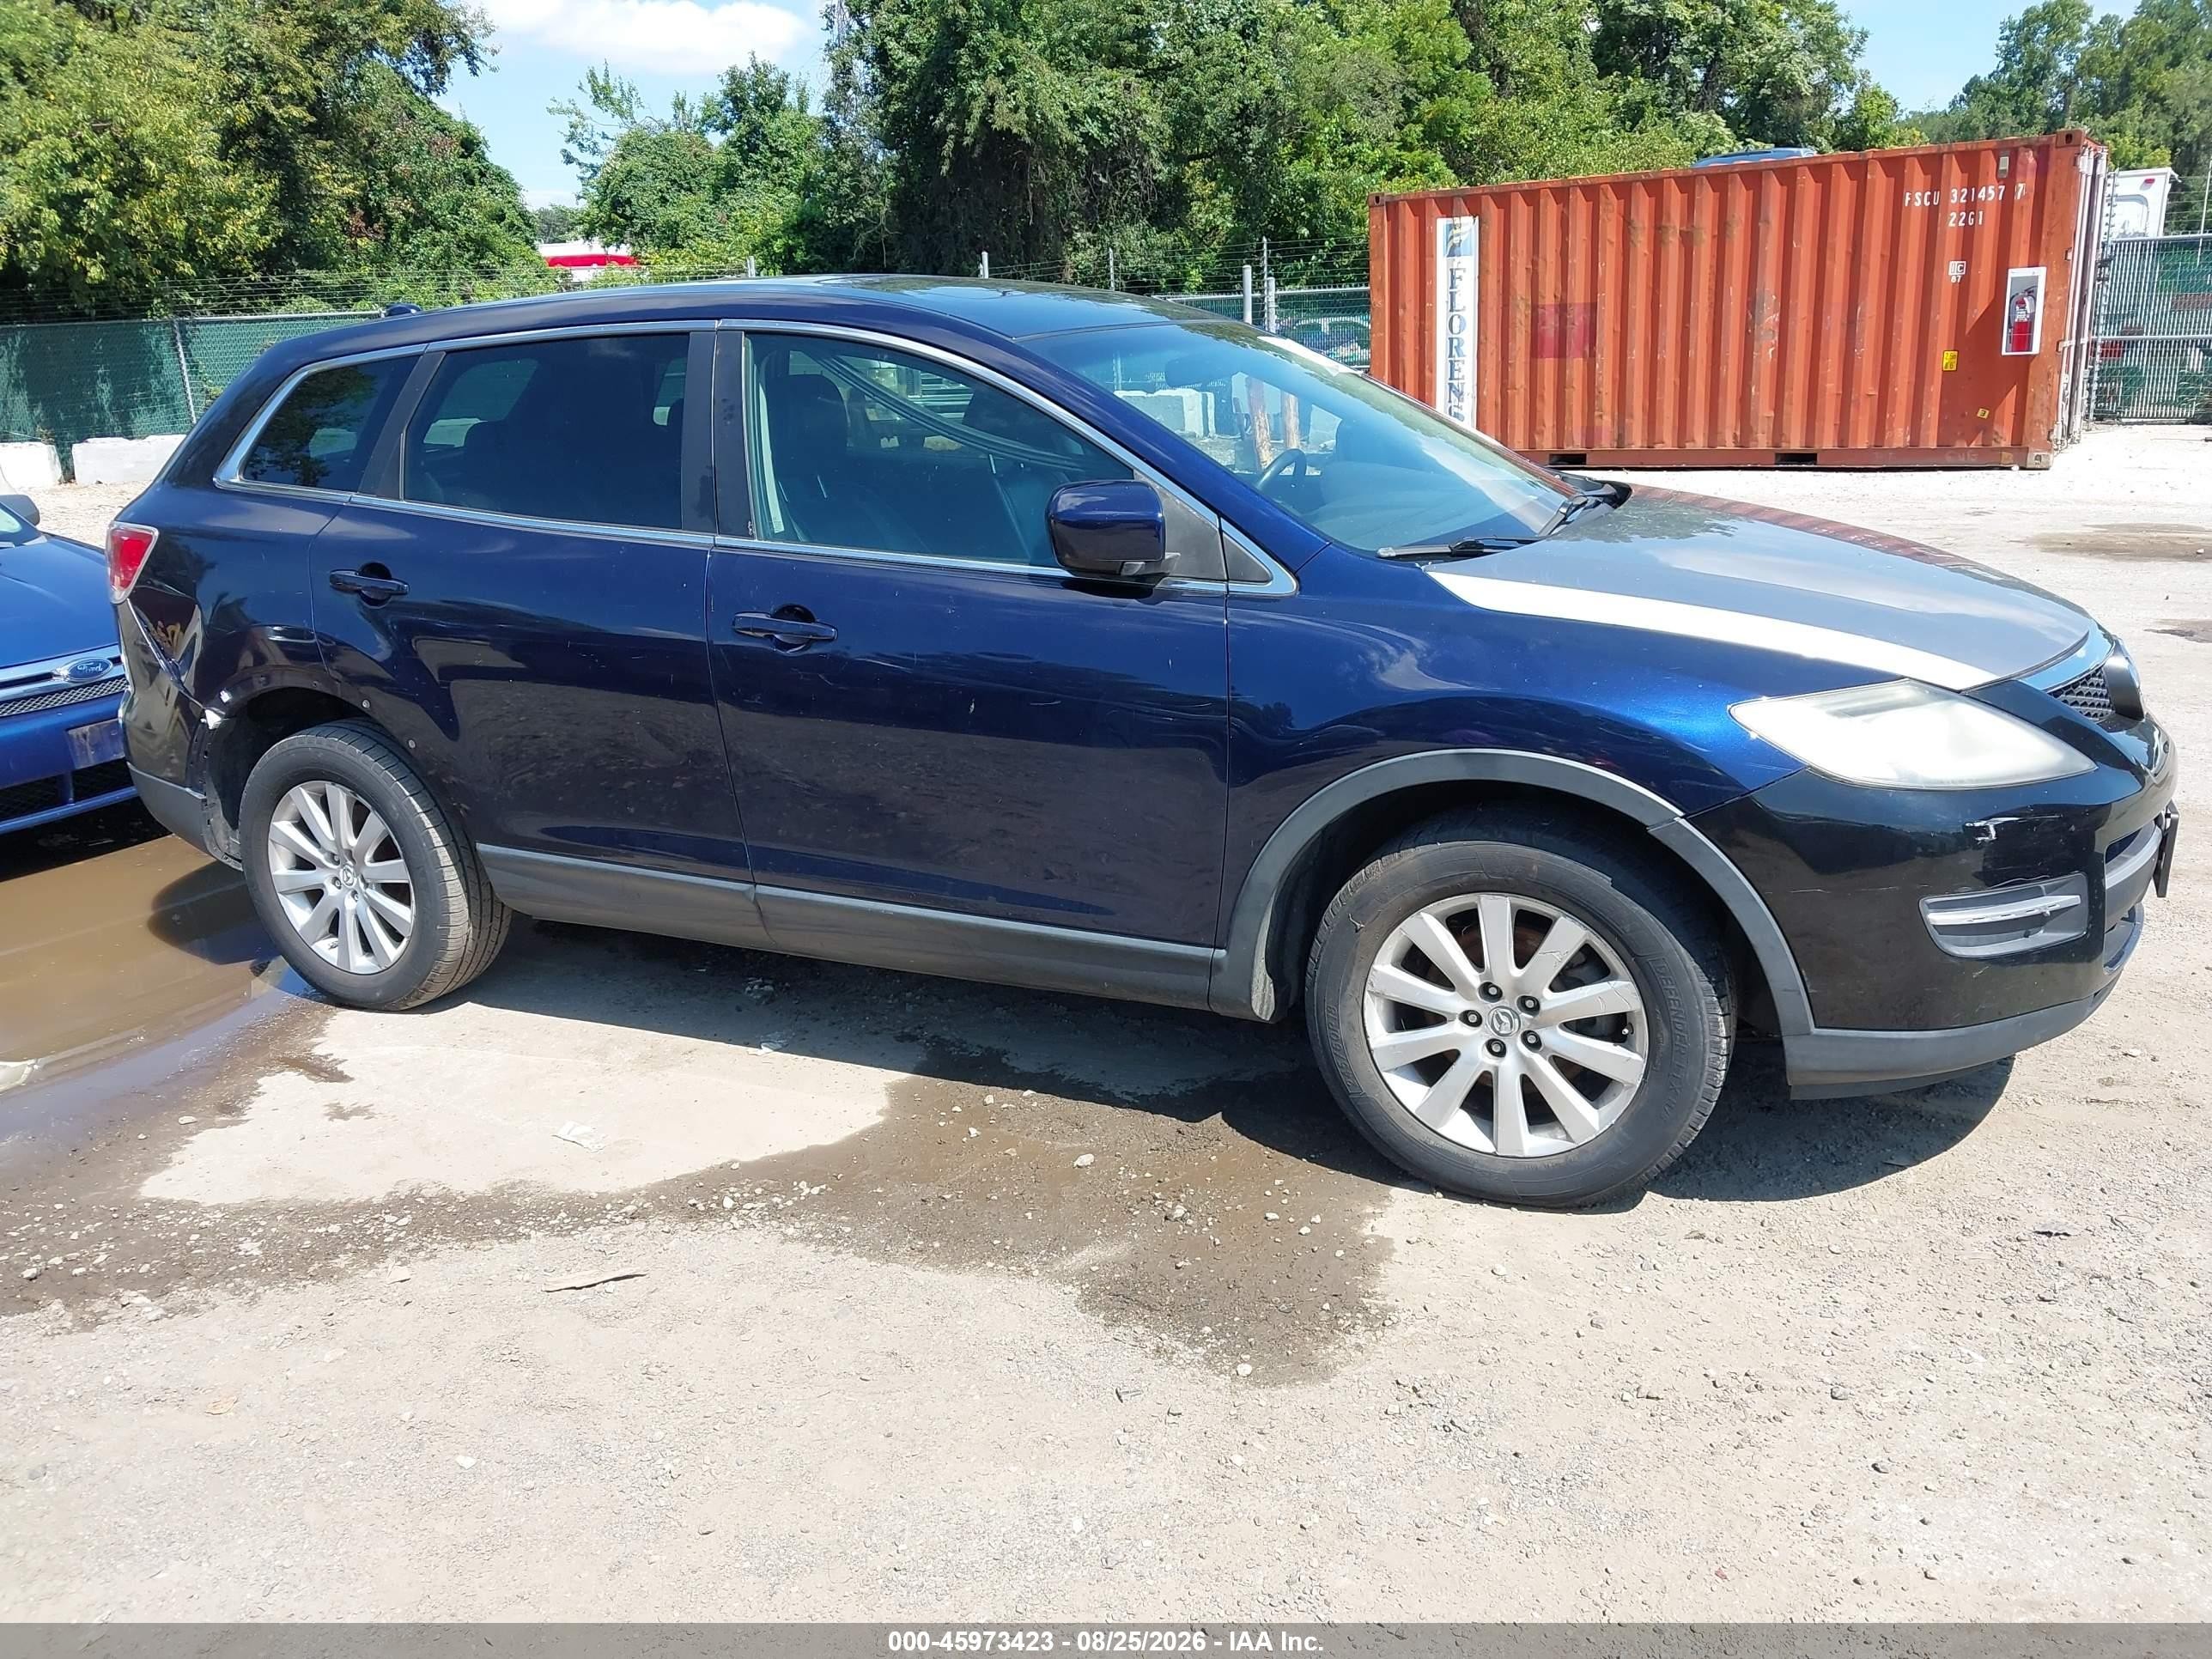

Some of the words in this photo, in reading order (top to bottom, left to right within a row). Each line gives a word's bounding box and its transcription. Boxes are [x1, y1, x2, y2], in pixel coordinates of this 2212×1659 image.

[1905, 191, 1940, 207] FSCU
[1950, 185, 2005, 204] 321457
[2014, 183, 2027, 200] 7
[1948, 210, 1984, 227] 22G1
[1654, 961, 1690, 1055] DEFENDER
